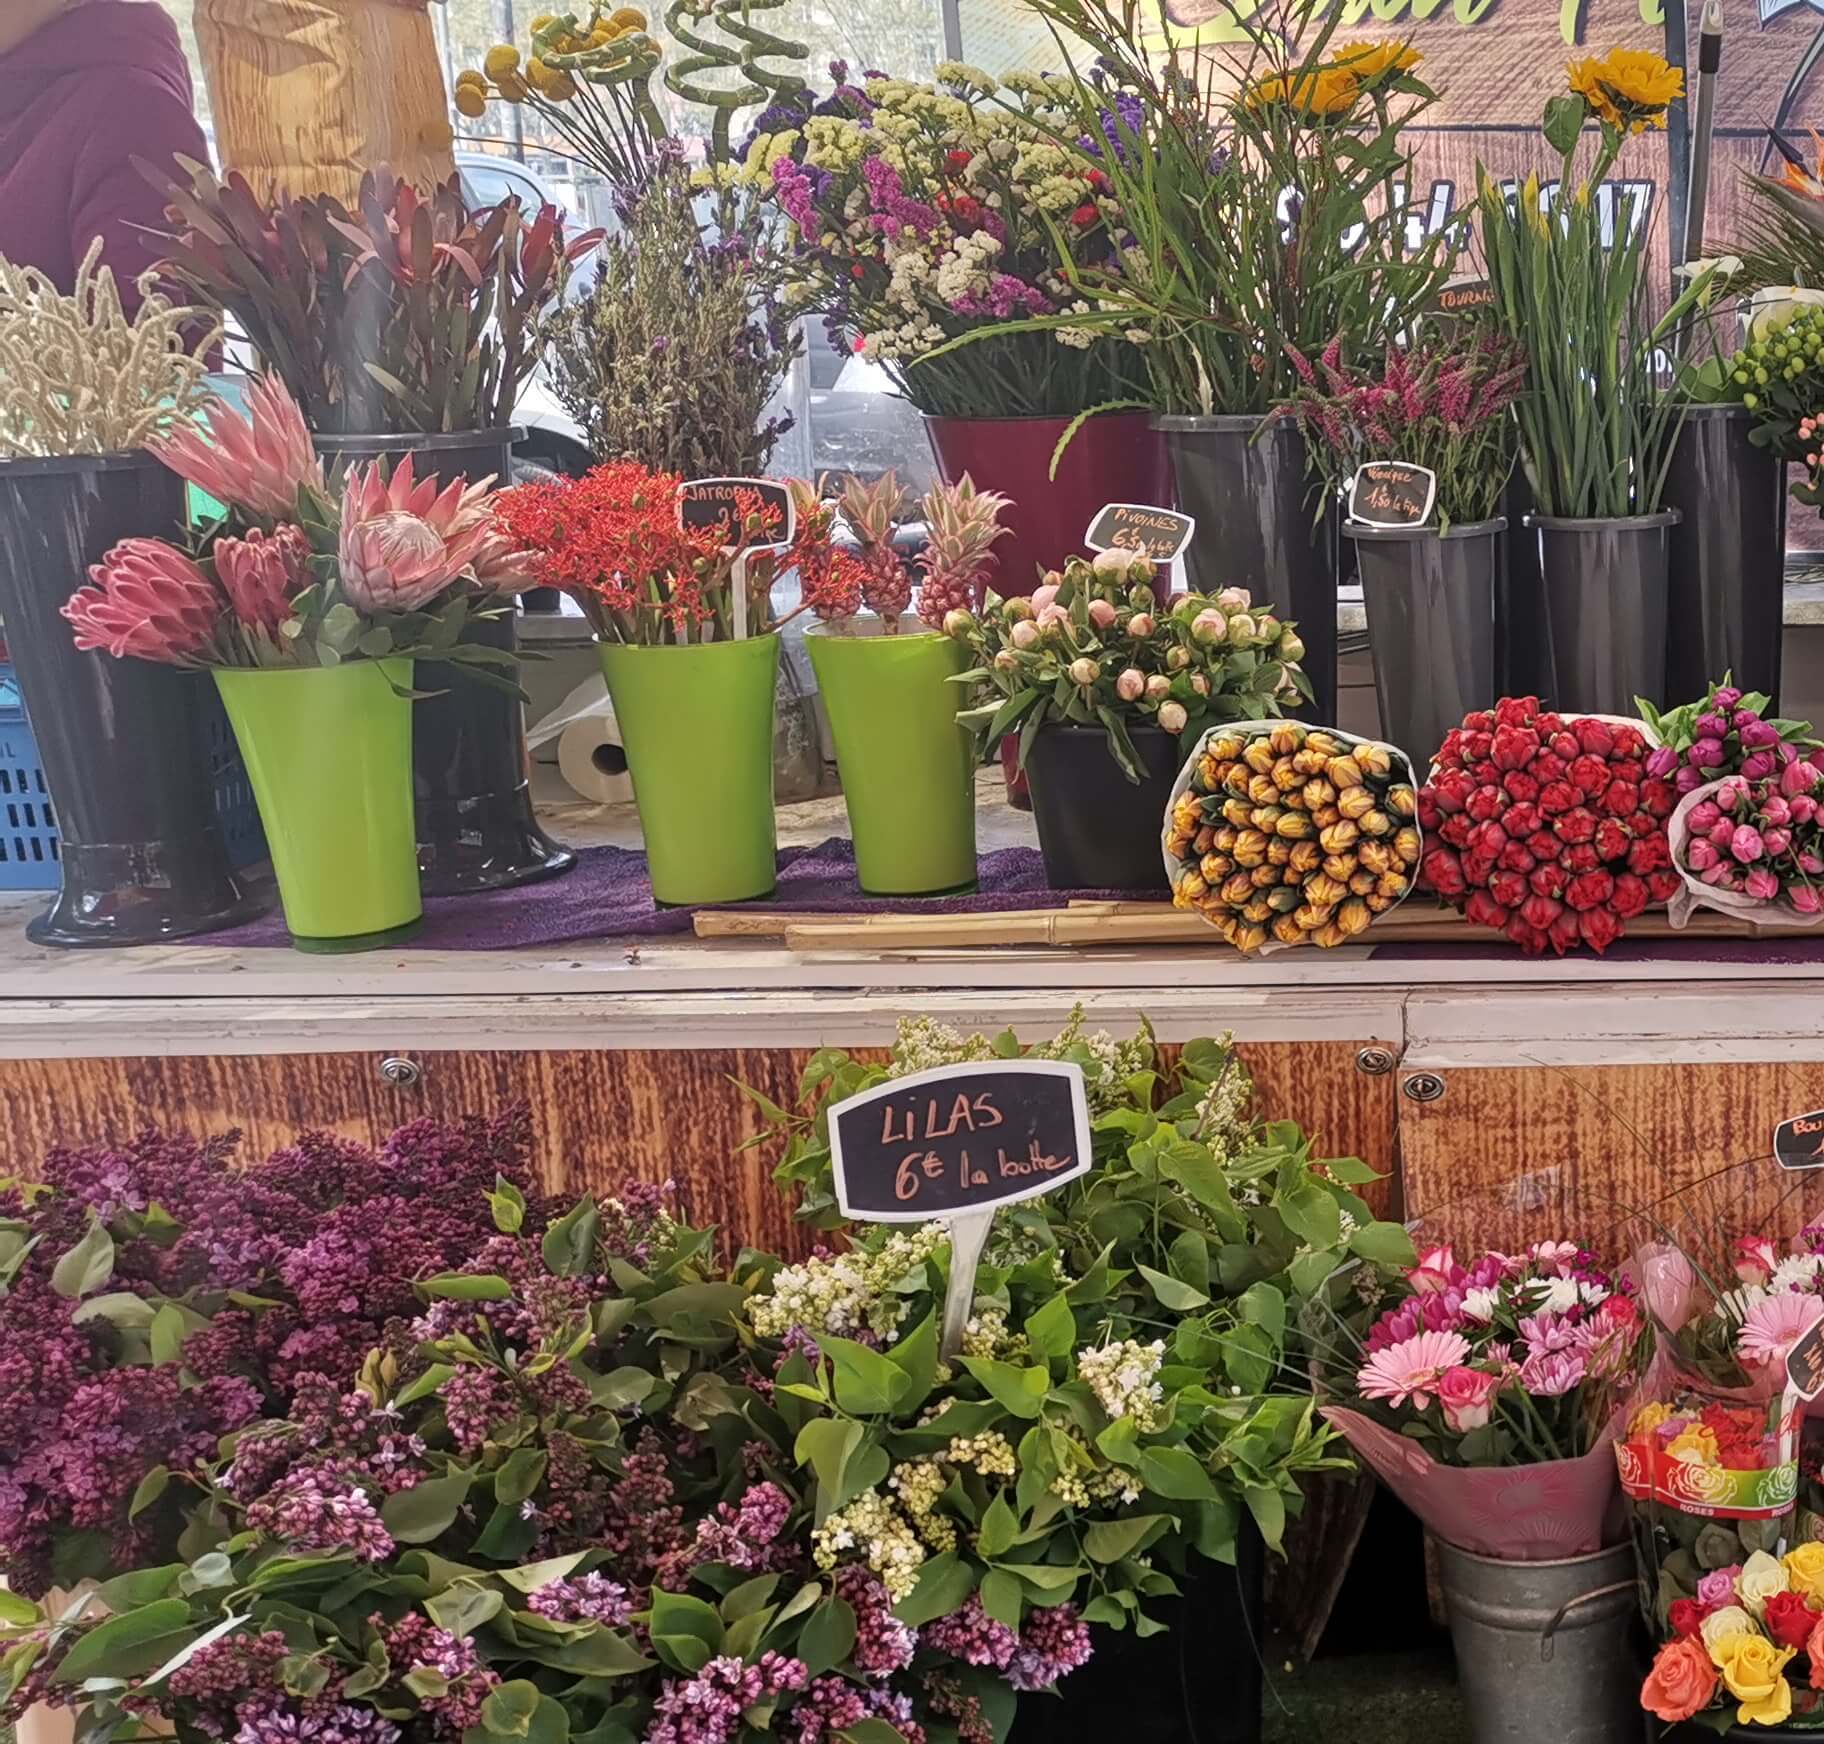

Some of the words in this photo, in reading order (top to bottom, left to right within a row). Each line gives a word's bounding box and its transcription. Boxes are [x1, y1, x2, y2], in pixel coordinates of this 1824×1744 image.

[895, 1150, 945, 1200] 6€
[960, 1150, 989, 1189] la
[999, 1139, 1072, 1177] botte
[1679, 1503, 1715, 1517] ROSES
